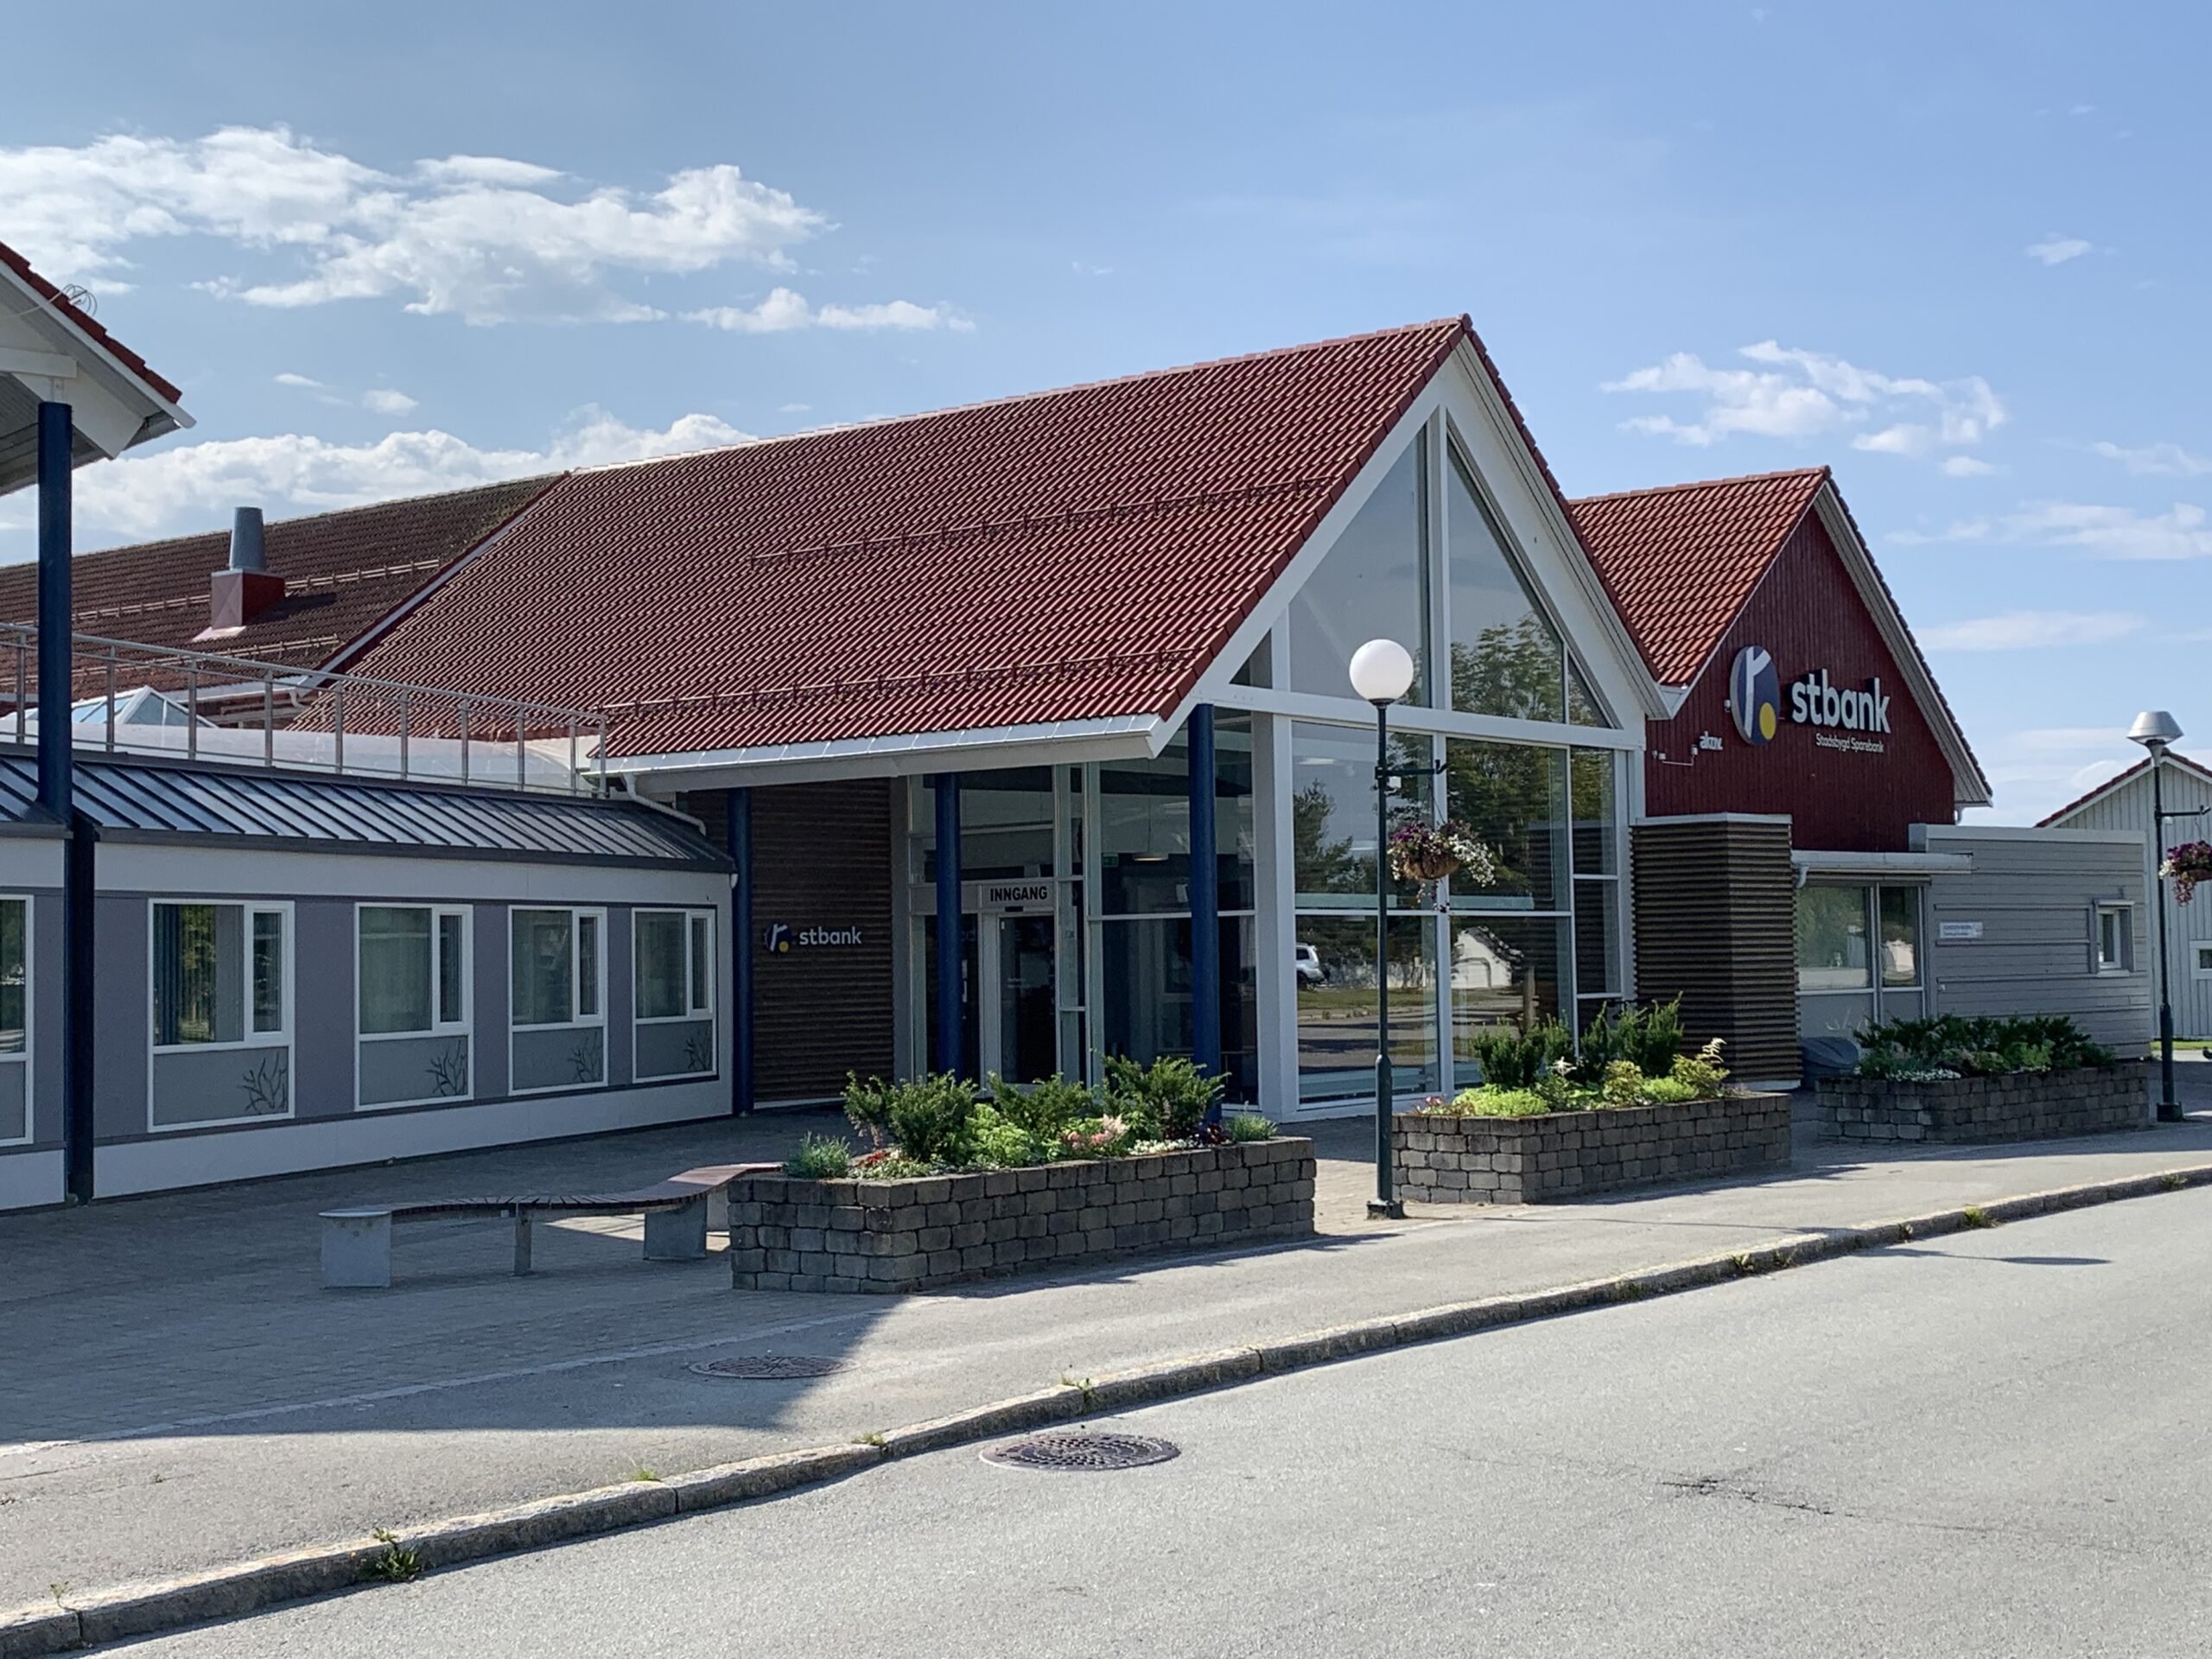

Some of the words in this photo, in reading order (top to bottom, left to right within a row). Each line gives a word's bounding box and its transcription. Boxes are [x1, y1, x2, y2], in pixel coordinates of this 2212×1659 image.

[1791, 669, 1891, 734] stbank
[989, 886, 1048, 902] INNGANG
[798, 926, 862, 945] stbank
